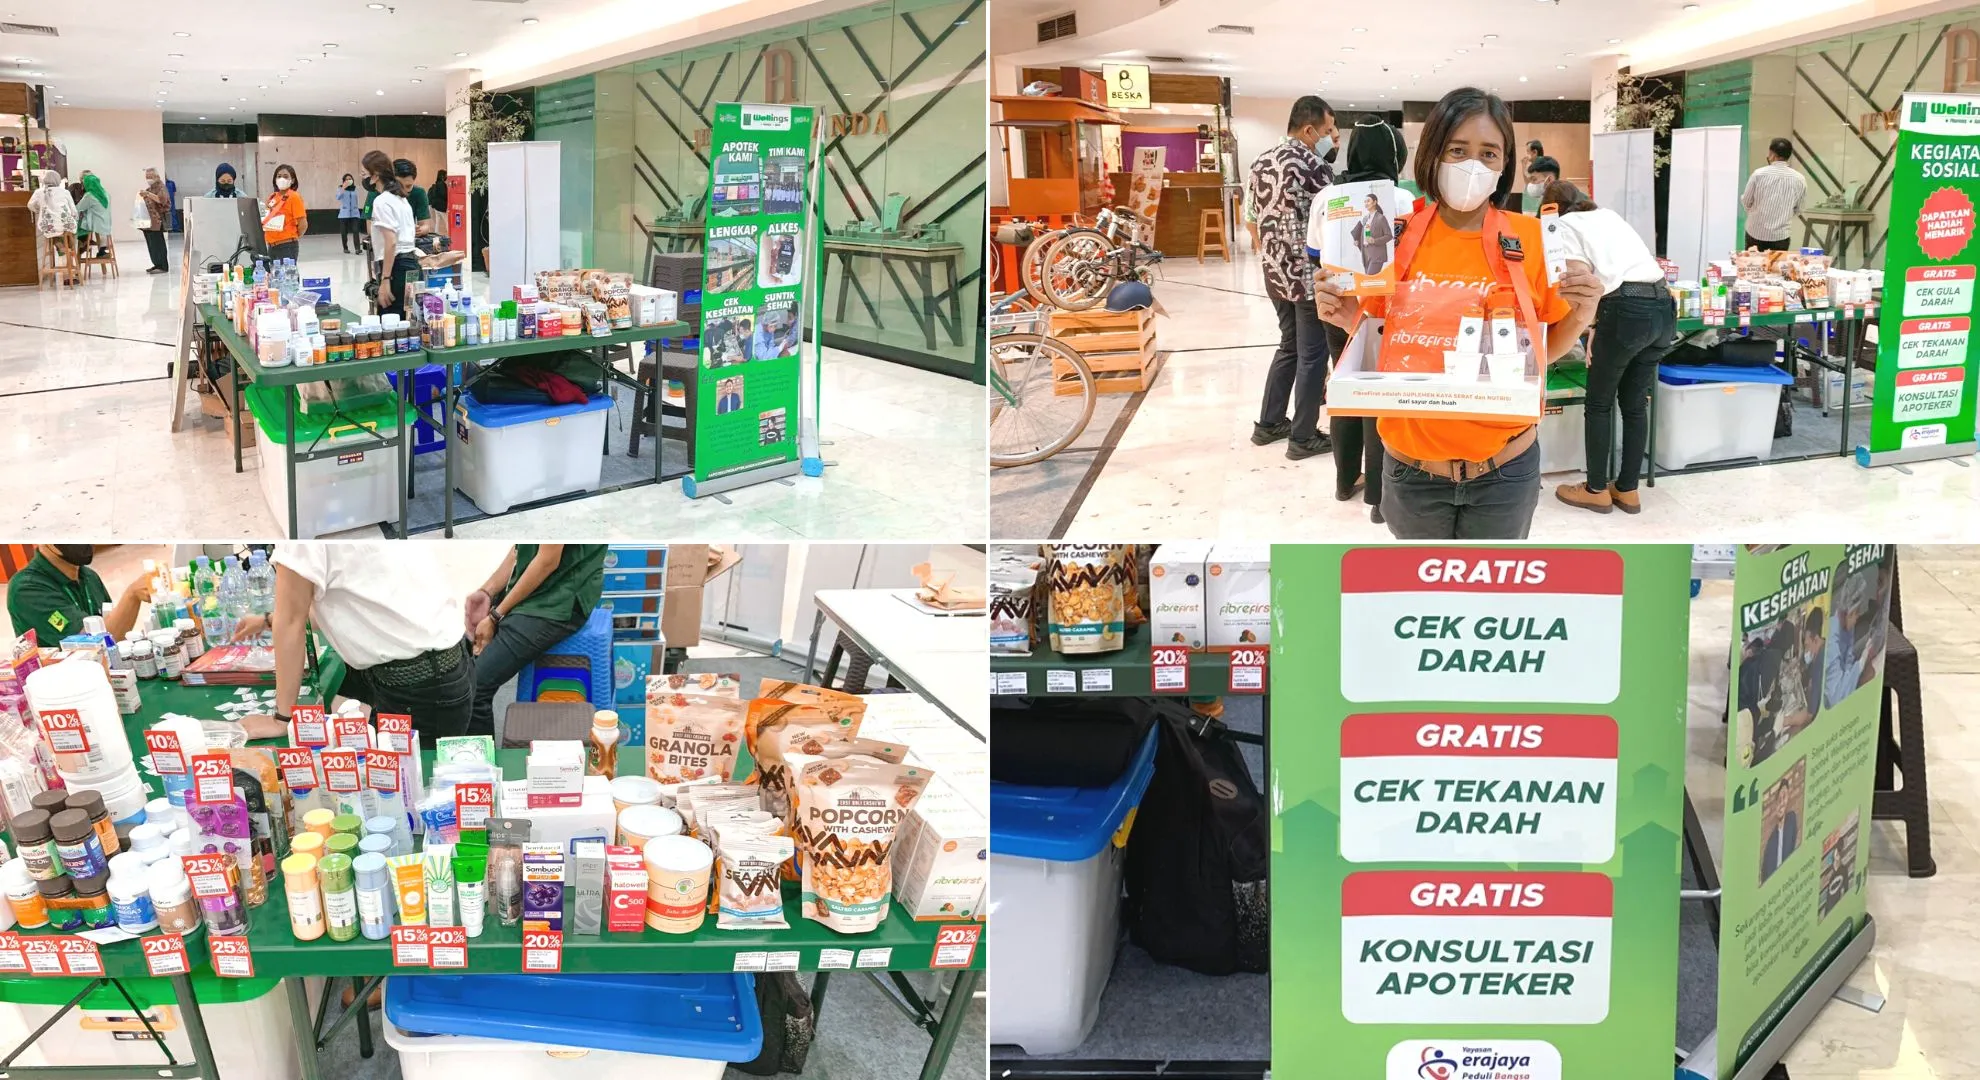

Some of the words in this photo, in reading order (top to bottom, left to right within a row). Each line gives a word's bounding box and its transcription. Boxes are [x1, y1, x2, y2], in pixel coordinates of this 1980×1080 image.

[753, 113, 789, 123] Wellings
[722, 142, 759, 152] APOTEK
[769, 148, 785, 157] TIM
[786, 148, 805, 157] KAMI
[1911, 144, 1980, 160] KEGIATA
[728, 152, 753, 162] KAMI
[1922, 163, 1979, 178] SOSIAL
[1922, 208, 1971, 222] DAPATKAN
[709, 225, 758, 238] LENGKAP
[768, 222, 799, 235] ALKES
[1927, 220, 1963, 230] HADIAH
[1924, 228, 1965, 240] MENARIK
[1923, 269, 1957, 279] GRATIS
[764, 292, 795, 303] SUNTIK
[1916, 287, 1935, 297] CEK
[1936, 286, 1960, 296] GULA
[724, 297, 739, 307] CEK
[767, 301, 793, 312] SEHAT
[1921, 298, 1954, 307] DARAH
[705, 305, 754, 319] KESEHATAN
[1918, 321, 1951, 331] GRATIS
[1902, 340, 1919, 350] CEK
[1922, 338, 1965, 348] TEKANAN
[1916, 349, 1949, 359] DARAH
[1912, 371, 1948, 382] GRATIS
[1898, 389, 1958, 402] KONSULTASI
[1901, 401, 1953, 413] APOTEKER
[1070, 551, 1109, 559] CASHEWS
[1848, 545, 1886, 574] SEHAT
[1418, 559, 1548, 584] GRATIS
[1782, 554, 1809, 585] CEK
[1743, 569, 1829, 628] KESEHATAN
[1155, 603, 1199, 613] fibrefirst
[1394, 615, 1465, 639] CEK
[1473, 616, 1568, 641] GULA
[1153, 650, 1187, 665] 20%
[1231, 650, 1265, 665] 20%
[1418, 648, 1546, 673] DARAH
[43, 713, 79, 729] 10%
[293, 709, 324, 723] 15%
[336, 721, 367, 735] 15%
[380, 718, 411, 733] 20%
[146, 734, 179, 749] 10%
[791, 731, 806, 739] NEW
[1415, 724, 1544, 748] GRATIS
[649, 736, 732, 756] GRANOLA
[280, 752, 312, 766] 20%
[323, 756, 356, 769] 20%
[366, 753, 399, 768] 20%
[668, 754, 708, 768] BITES
[194, 759, 230, 776] 25%
[457, 788, 491, 803] 15%
[1353, 779, 1424, 803] CEK
[1434, 780, 1605, 804] TEKANAN
[810, 807, 909, 825] POPCORN
[1415, 811, 1541, 834] DARAH
[823, 825, 849, 834] WITH
[851, 824, 895, 834] CASHEWS
[186, 858, 223, 874] 25%
[526, 865, 562, 873] Sambucol
[933, 876, 982, 886] fibrefirst
[1409, 882, 1546, 907] GRATIS
[393, 929, 427, 942] 15%
[429, 931, 465, 944] 20%
[525, 934, 560, 948] 20%
[939, 929, 976, 944] 20%
[22, 940, 57, 953] 25%
[60, 938, 97, 953] 25%
[144, 938, 182, 954] 20%
[212, 940, 248, 954] 25%
[1359, 939, 1594, 963] KONSULTASI
[1376, 972, 1575, 995] APOTEKER
[1462, 1046, 1492, 1054] Yayasan
[1462, 1053, 1531, 1069] erajaya
[1462, 1072, 1493, 1080] Peduli
[1494, 1072, 1530, 1080] Bangsa
